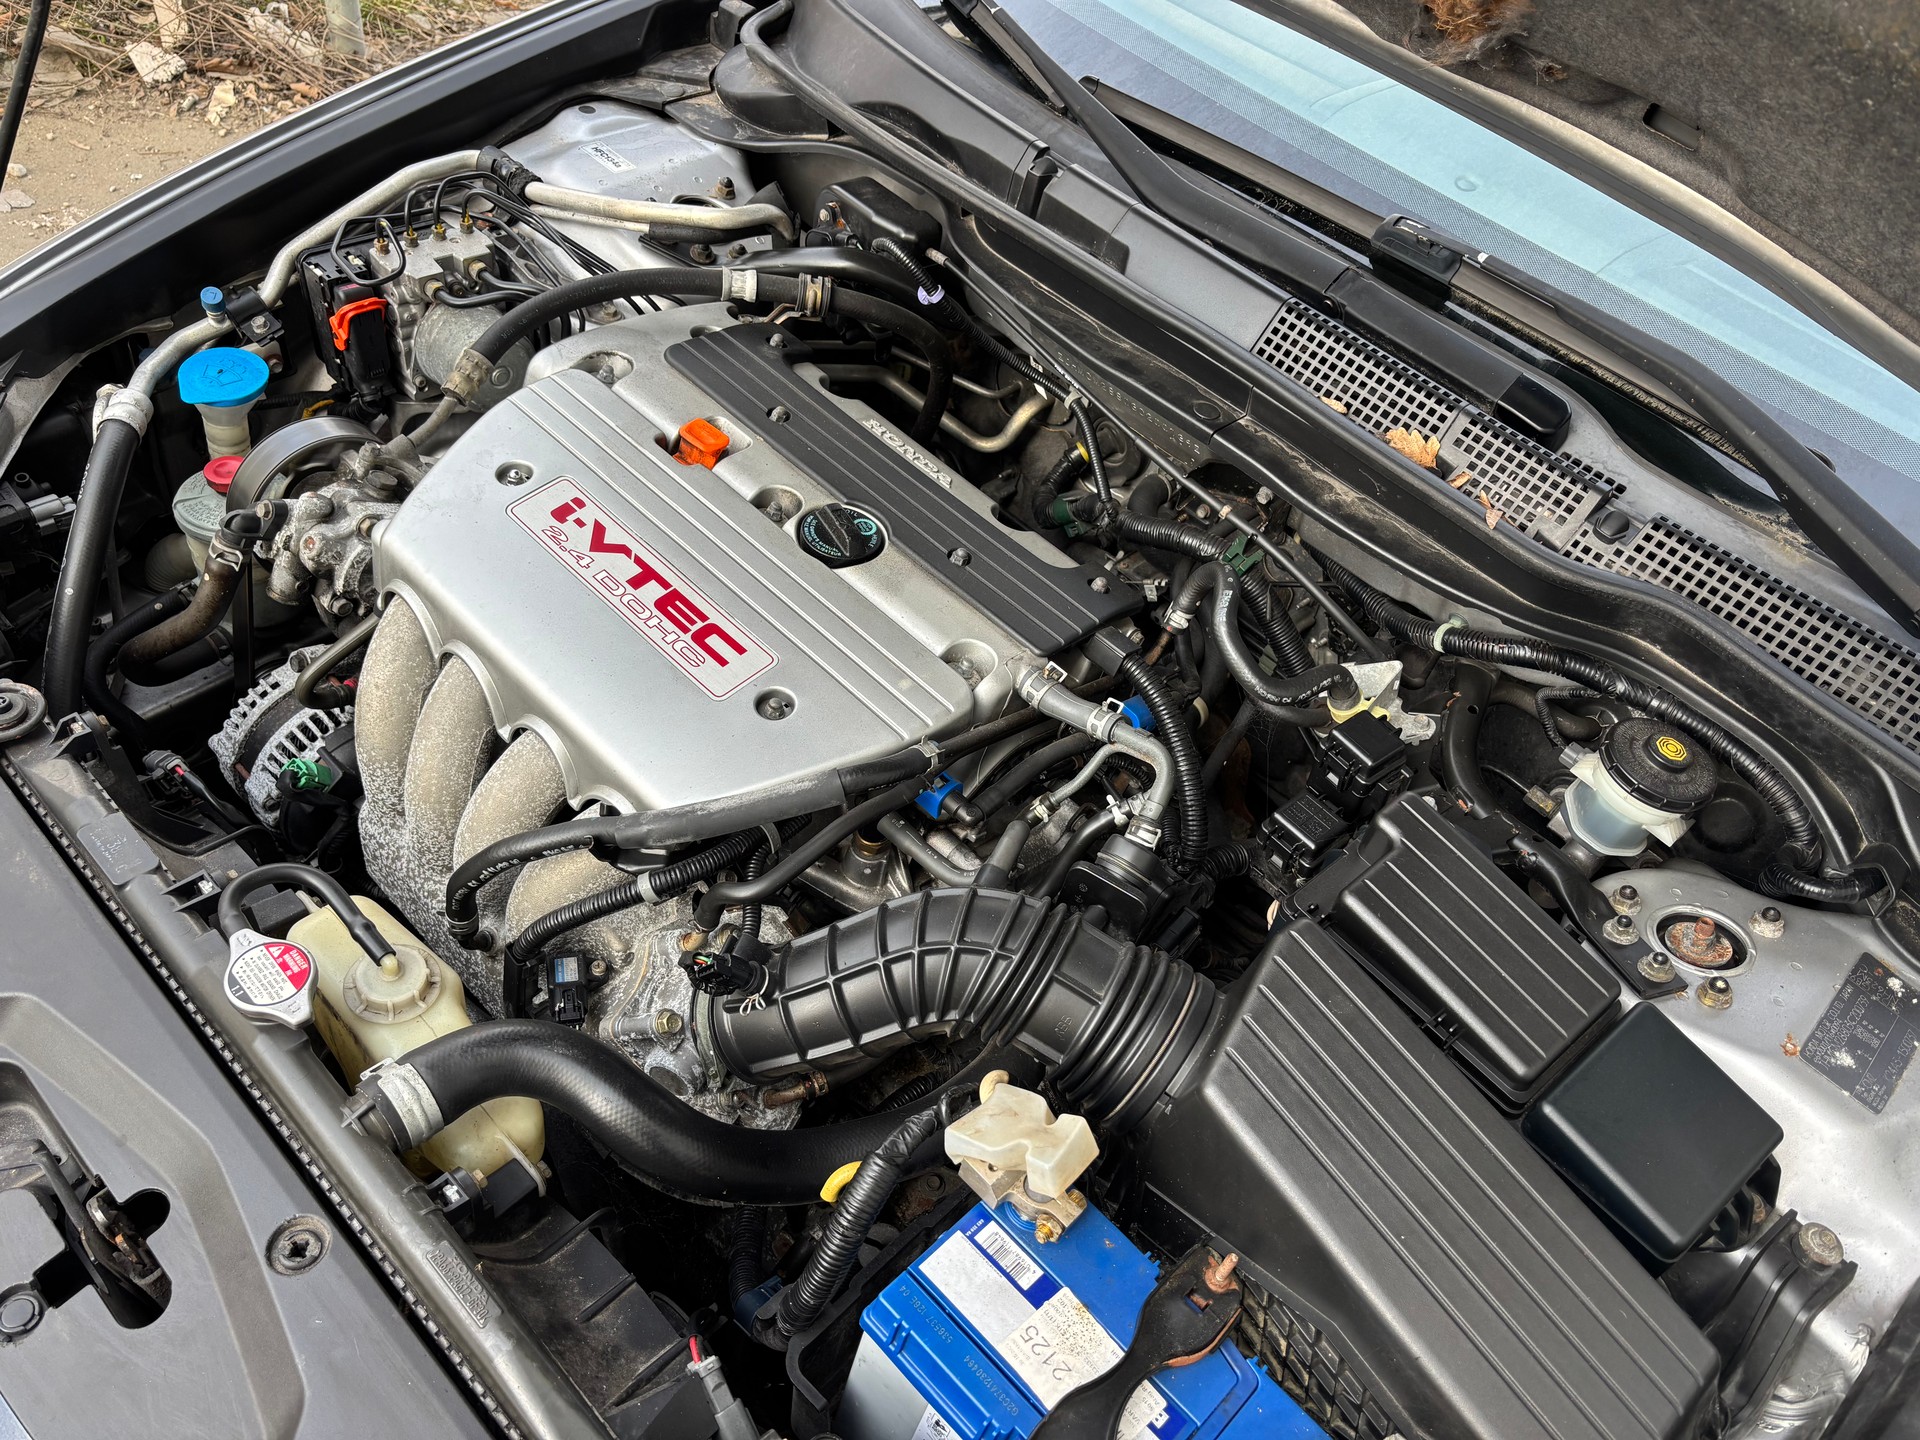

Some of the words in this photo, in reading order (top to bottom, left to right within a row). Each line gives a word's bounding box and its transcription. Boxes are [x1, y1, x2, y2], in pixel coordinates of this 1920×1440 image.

[862, 418, 952, 488] HONDA
[541, 525, 594, 570] 2.4
[592, 569, 707, 668] DOHC
[550, 495, 747, 667] i-VTEC
[289, 948, 308, 970] DANGER
[1803, 1038, 1820, 1059] HONDA
[1814, 1017, 1833, 1040] MOTOR
[1839, 982, 1855, 1002] JAPAN
[447, 1253, 490, 1305] HONDA
[1017, 1322, 1072, 1382] 2125
